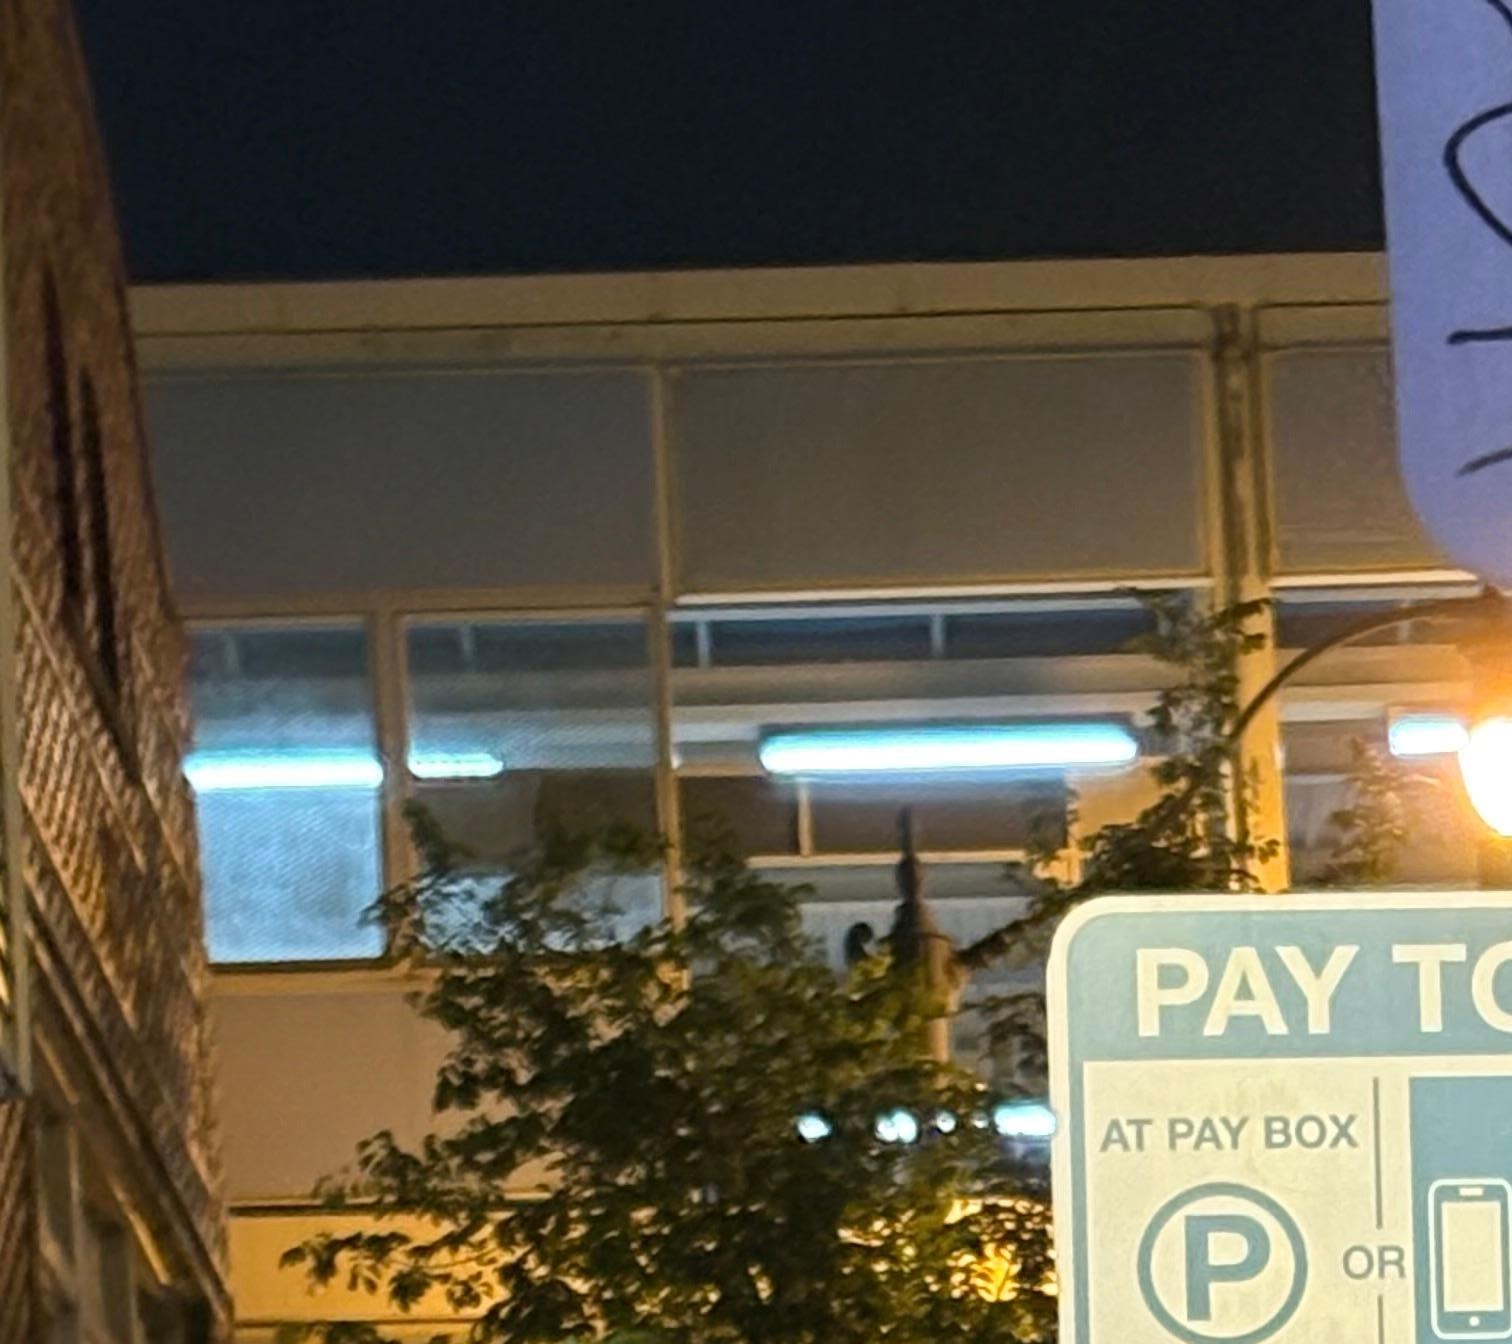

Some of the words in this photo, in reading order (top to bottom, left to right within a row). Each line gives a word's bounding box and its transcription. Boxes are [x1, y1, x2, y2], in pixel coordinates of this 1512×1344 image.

[1136, 944, 1360, 1037] PAY
[1100, 1118, 1153, 1152] AT
[1168, 1115, 1250, 1150] PAY
[1264, 1113, 1359, 1149] BOX
[1184, 1213, 1272, 1323] P
[1342, 1244, 1407, 1282] OR
